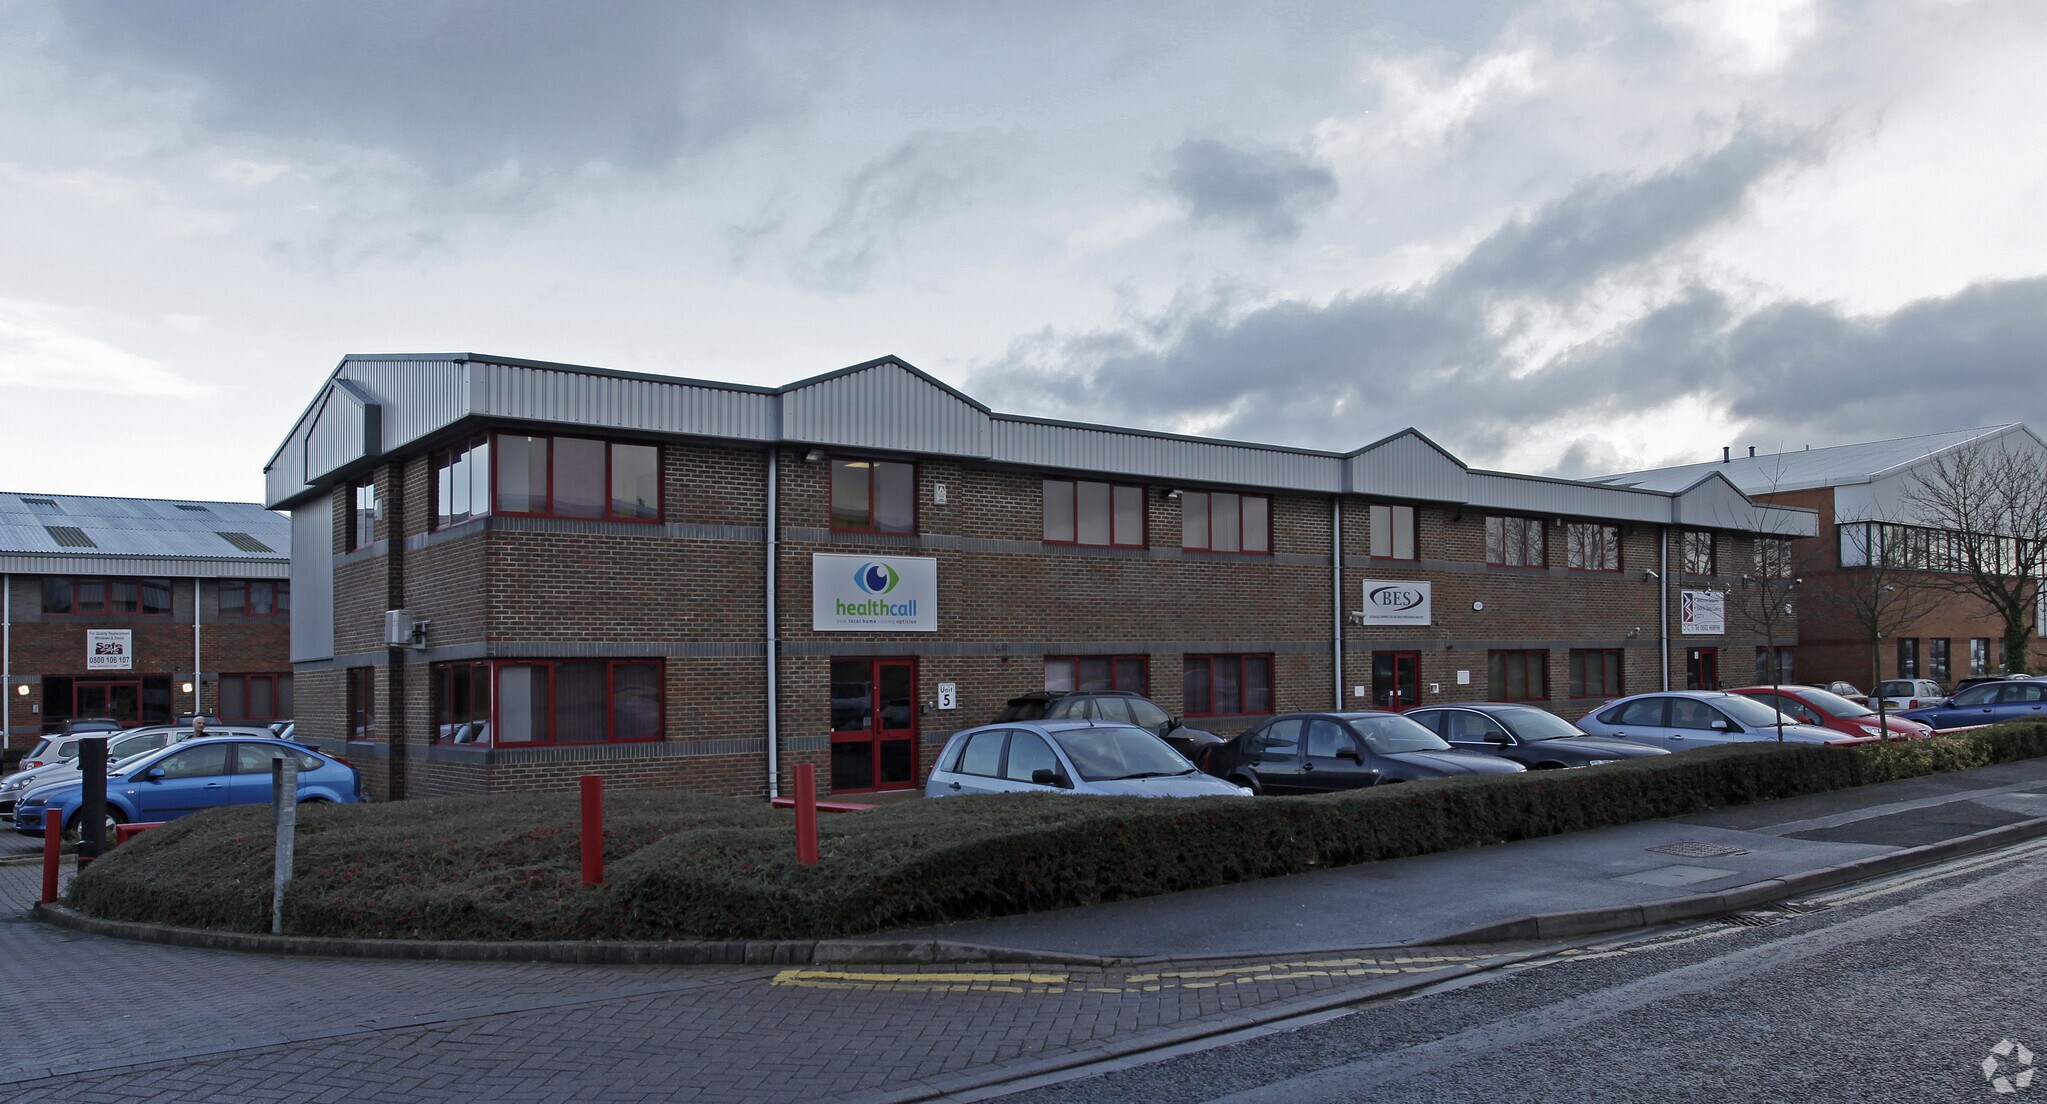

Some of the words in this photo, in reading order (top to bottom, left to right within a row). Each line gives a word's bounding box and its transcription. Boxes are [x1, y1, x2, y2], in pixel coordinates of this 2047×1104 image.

[1382, 591, 1411, 606] BES
[836, 598, 917, 616] healthcall
[944, 694, 950, 706] 5
